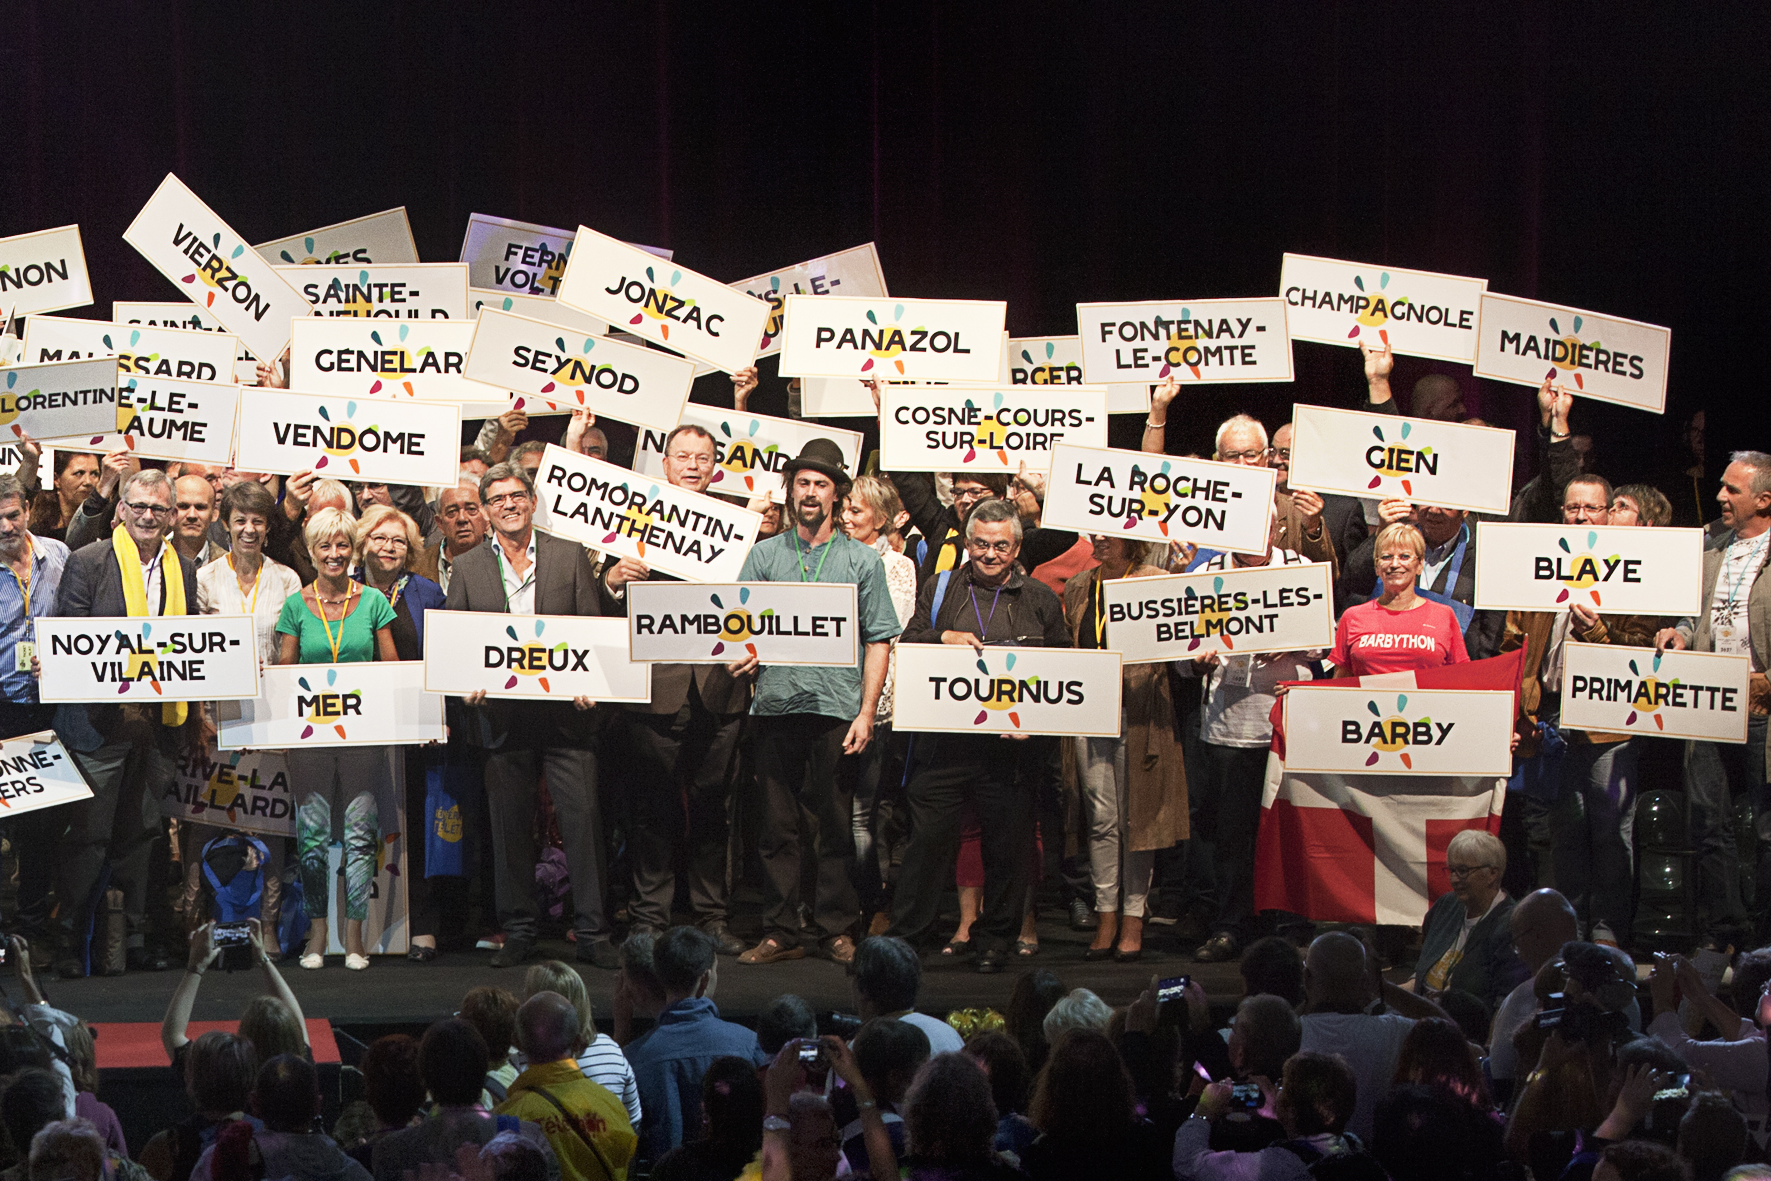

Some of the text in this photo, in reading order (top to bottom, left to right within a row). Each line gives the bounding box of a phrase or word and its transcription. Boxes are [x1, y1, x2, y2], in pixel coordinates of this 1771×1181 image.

[172, 224, 269, 321] VIERZON
[304, 283, 419, 304] SAINTE-
[605, 276, 724, 337] JONZAC
[1285, 286, 1473, 330] CHAMPAGNOLE
[816, 327, 970, 353] PANAZOL
[1101, 317, 1265, 342] FONTENAY-
[315, 348, 467, 374] GÉNELAR
[512, 345, 640, 395] SEYNOD
[1115, 345, 1257, 369] LE-COMTE
[118, 416, 207, 442] AUME
[895, 405, 1094, 428] COSNE-COURS-
[273, 422, 425, 455] VENDÔME
[1366, 447, 1438, 476] GIEN
[1076, 463, 1242, 503] LA ROCHE-
[548, 466, 743, 542] ROMORANTIN-
[1089, 494, 1226, 531] SUR-YON
[552, 495, 725, 564] LANTHENAY
[1536, 558, 1641, 583] BLAYE
[636, 614, 846, 638] RAMBOUILLET
[1156, 614, 1279, 642] BELMONT
[51, 632, 240, 655] NOYAL-SUR-
[1359, 632, 1435, 651] BARBYTHON
[91, 660, 205, 683] VILAINE
[485, 646, 589, 672] DREUX
[929, 677, 1084, 704] TOURNUS
[1572, 675, 1736, 711] PRIMARETTE
[297, 695, 362, 717] MER
[1341, 720, 1455, 745] BARBY
